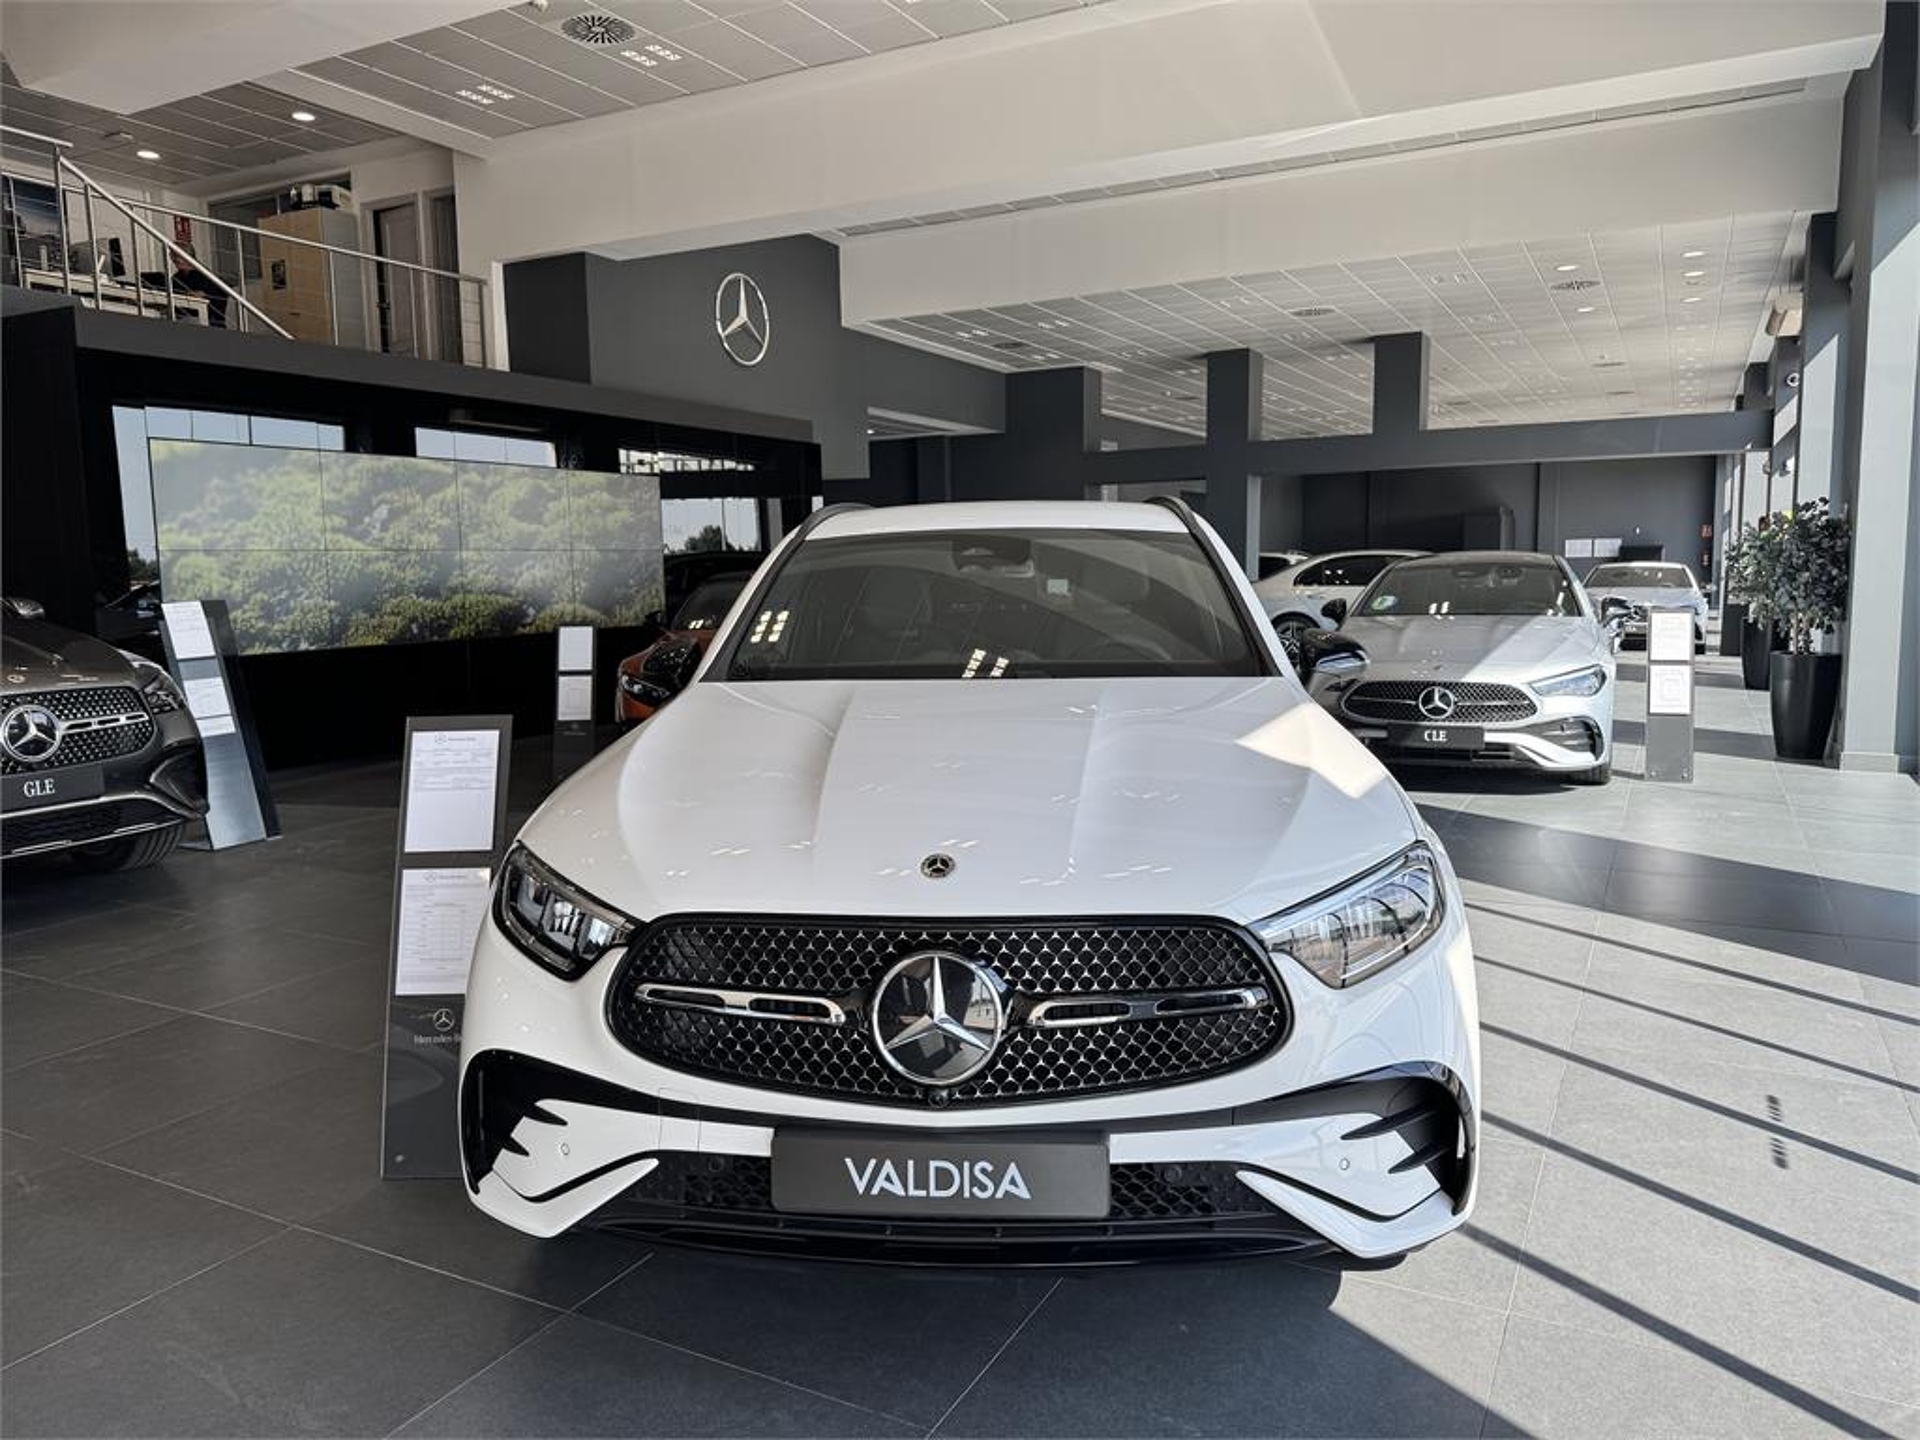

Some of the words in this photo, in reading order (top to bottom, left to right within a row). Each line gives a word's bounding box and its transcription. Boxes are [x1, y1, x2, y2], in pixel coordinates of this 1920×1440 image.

[1424, 730, 1448, 741] CLE
[24, 778, 55, 797] GLE
[844, 1158, 1032, 1199] VALDISA
